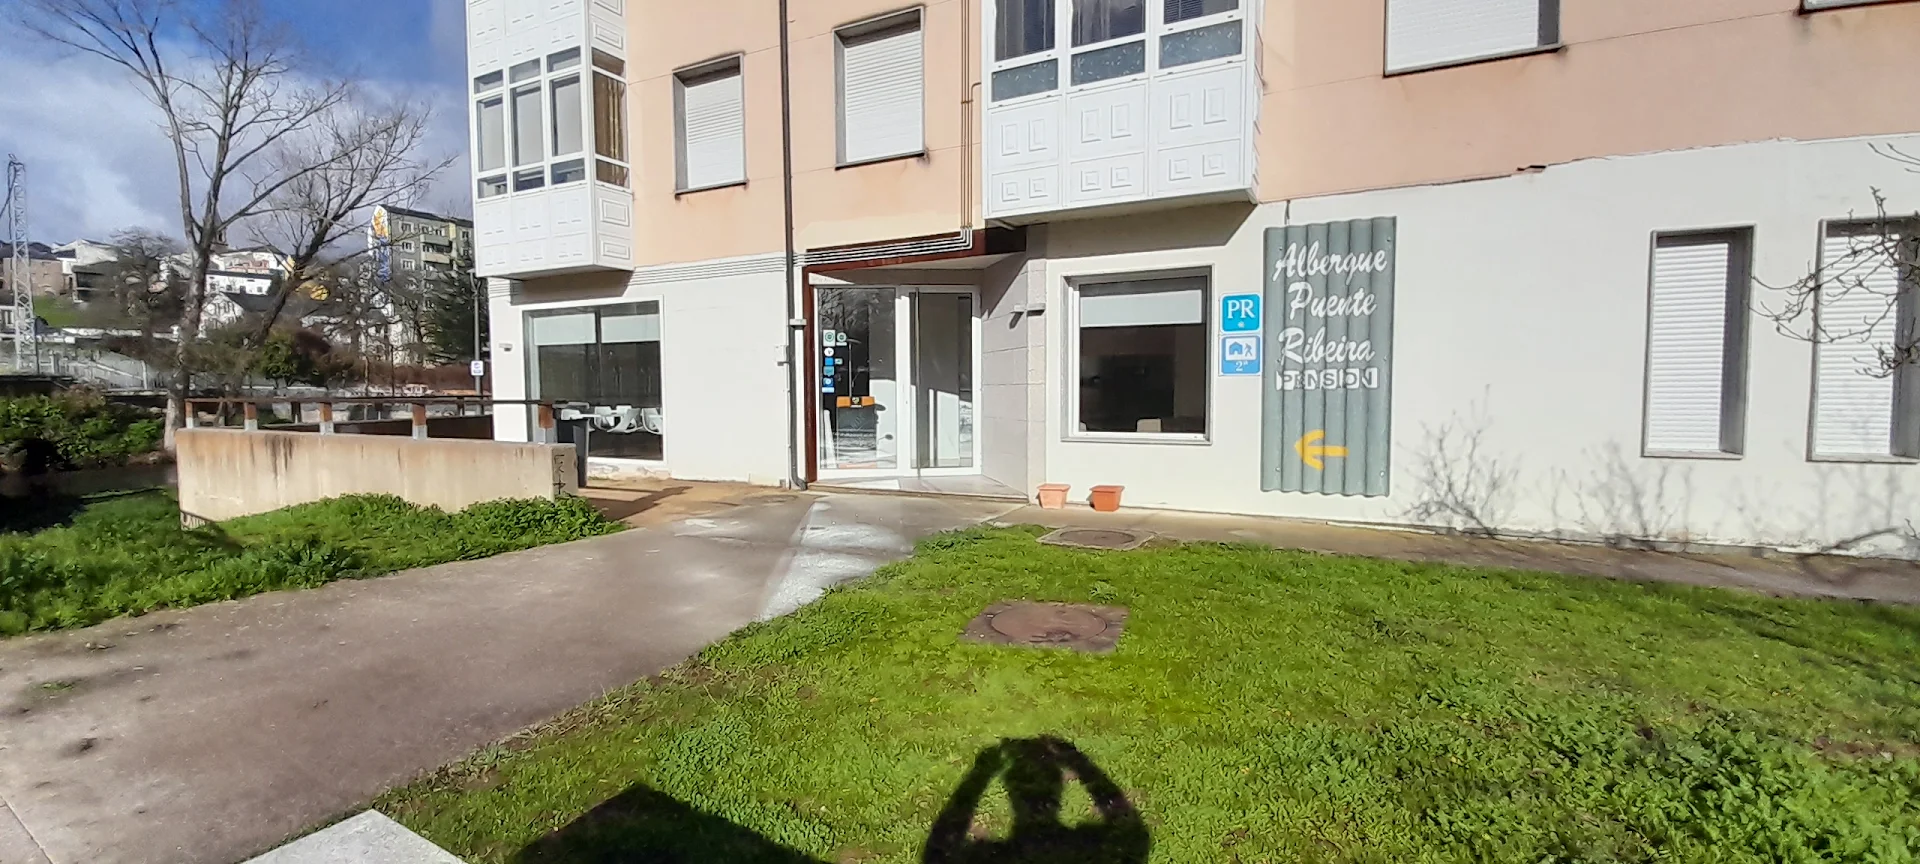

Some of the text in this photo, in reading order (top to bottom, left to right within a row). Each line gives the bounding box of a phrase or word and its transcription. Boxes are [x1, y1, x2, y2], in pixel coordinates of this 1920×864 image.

[1272, 240, 1388, 285] Albergue
[1227, 299, 1255, 319] PR
[1287, 281, 1377, 320] Puente
[1278, 326, 1375, 366] Ribeira
